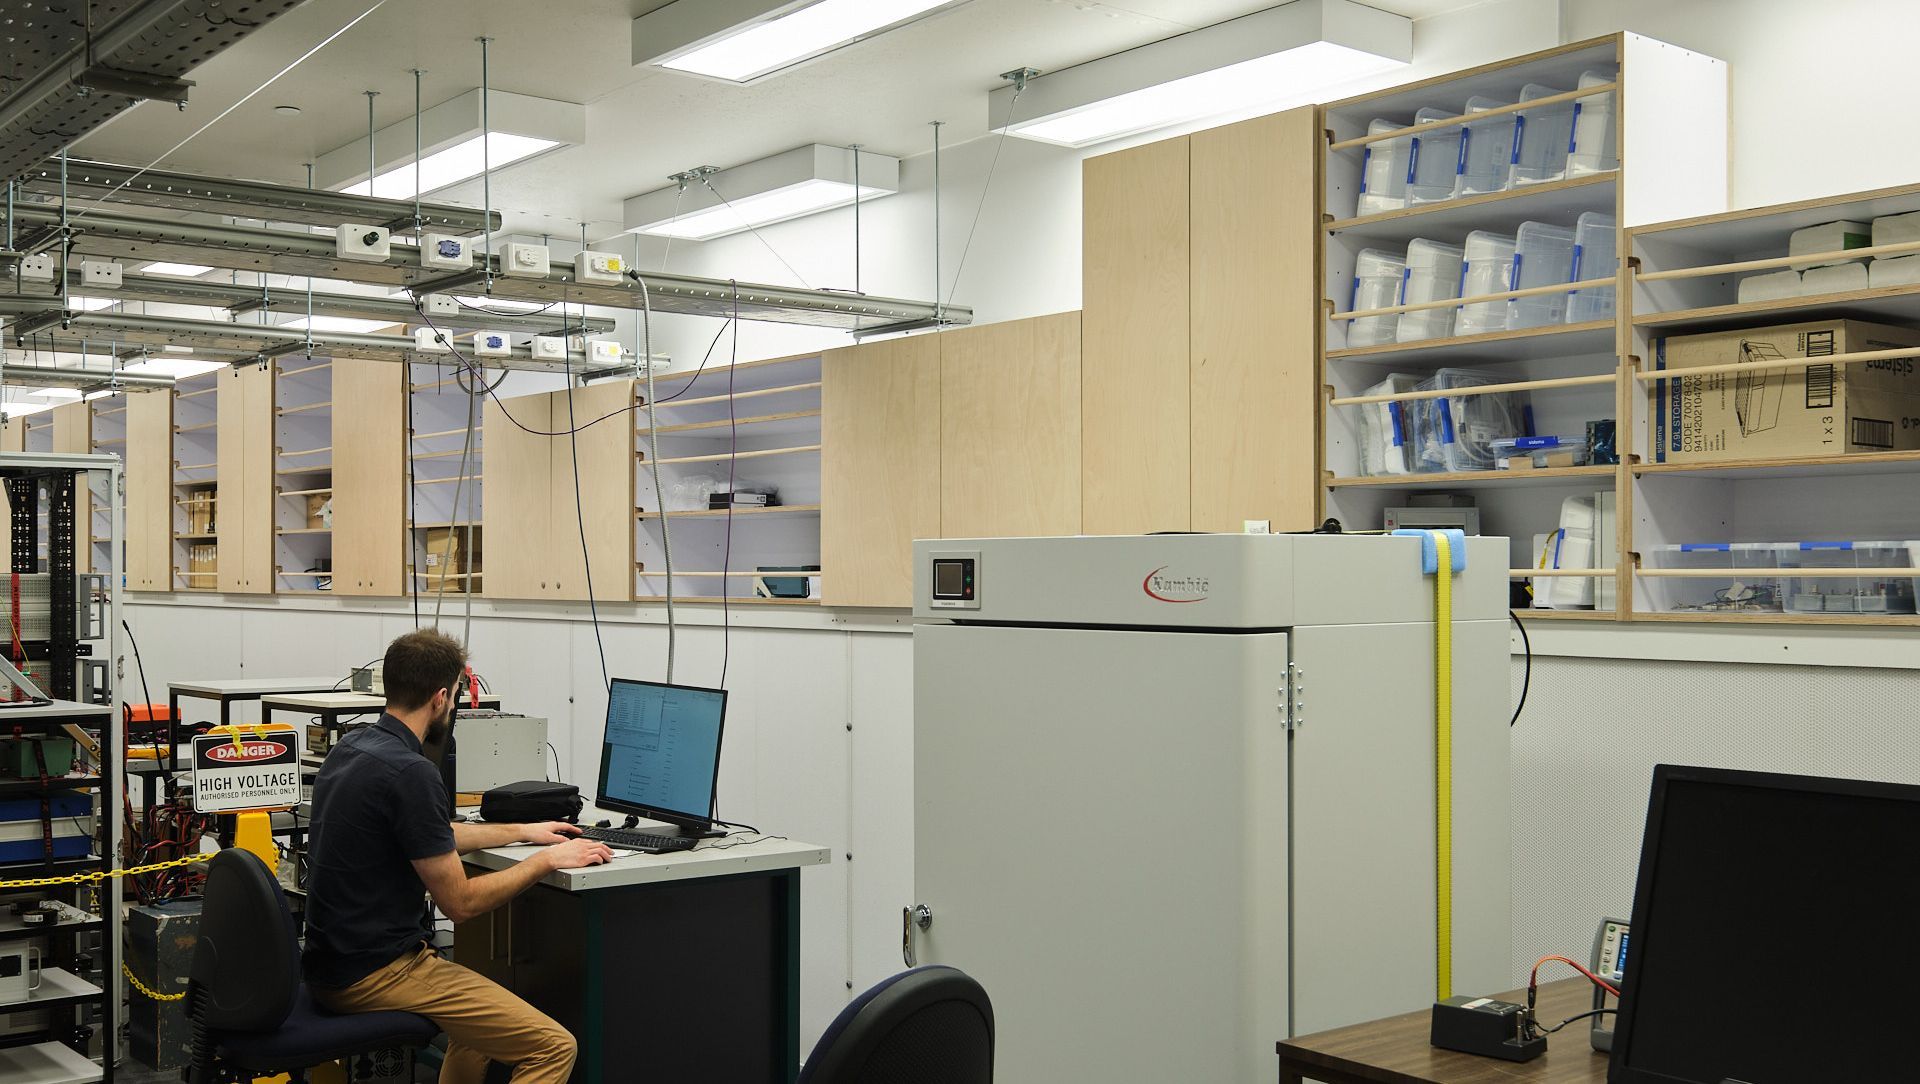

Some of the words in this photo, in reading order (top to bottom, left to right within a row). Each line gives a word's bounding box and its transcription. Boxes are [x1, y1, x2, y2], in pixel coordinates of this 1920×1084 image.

[1673, 380, 1681, 426] STORAGE
[1684, 375, 1693, 421] 70078-02
[1823, 416, 1833, 424] 3
[1673, 427, 1681, 448] 7.9L
[1684, 424, 1693, 452] CODE
[217, 745, 276, 759] DANGER
[200, 777, 232, 792] HIGH
[237, 773, 296, 789] VOLTAGE
[200, 791, 240, 801] AUTHORISED
[241, 788, 278, 798] PERSONNEL
[279, 787, 296, 795] ONLY
